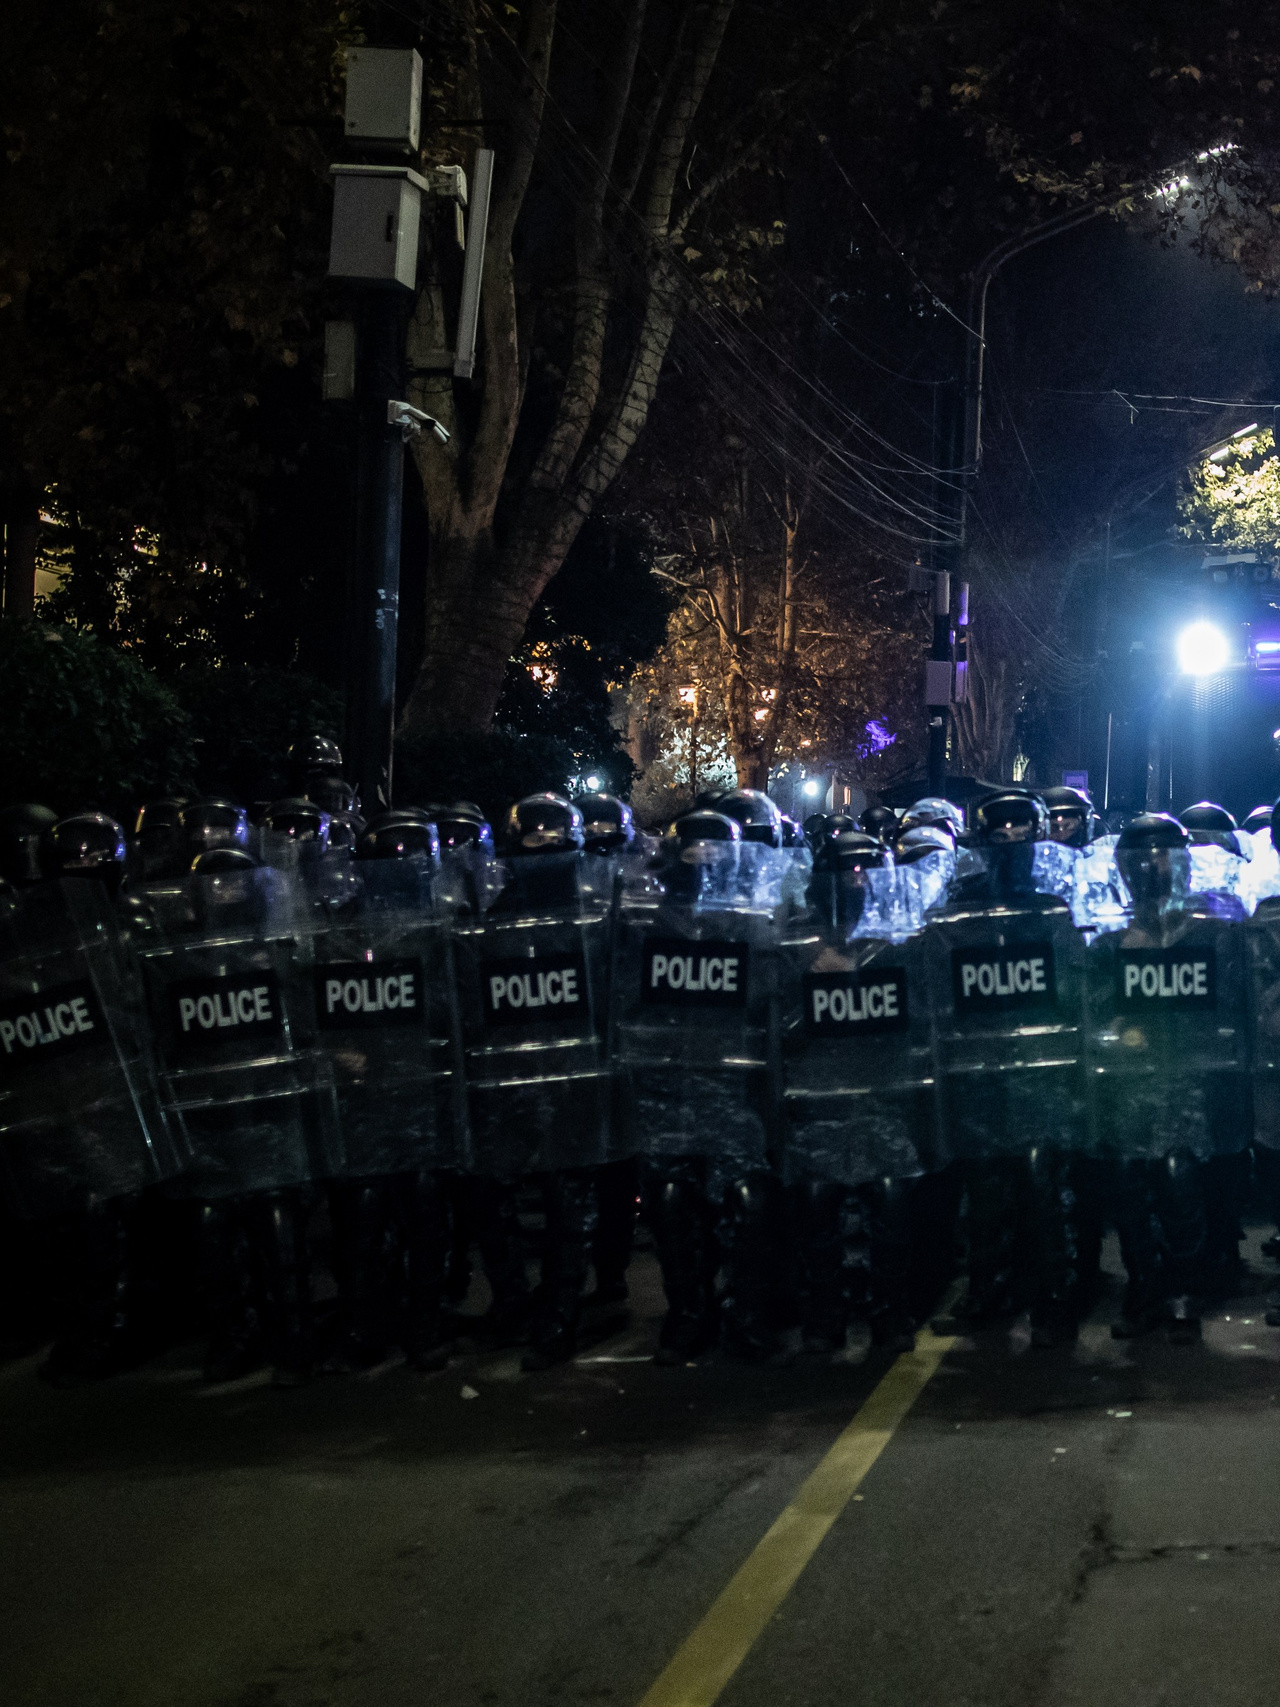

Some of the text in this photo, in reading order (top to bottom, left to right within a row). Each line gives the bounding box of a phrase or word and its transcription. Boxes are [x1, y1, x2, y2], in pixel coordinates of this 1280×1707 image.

[325, 973, 416, 1013] POLICE
[489, 968, 580, 1010] POLICE
[650, 954, 739, 992] POLICE
[961, 957, 1047, 997] POLICE
[1124, 961, 1208, 998] POLICE
[178, 985, 273, 1032] POLICE
[812, 982, 899, 1023] POLICE
[0, 997, 94, 1054] POLICE
